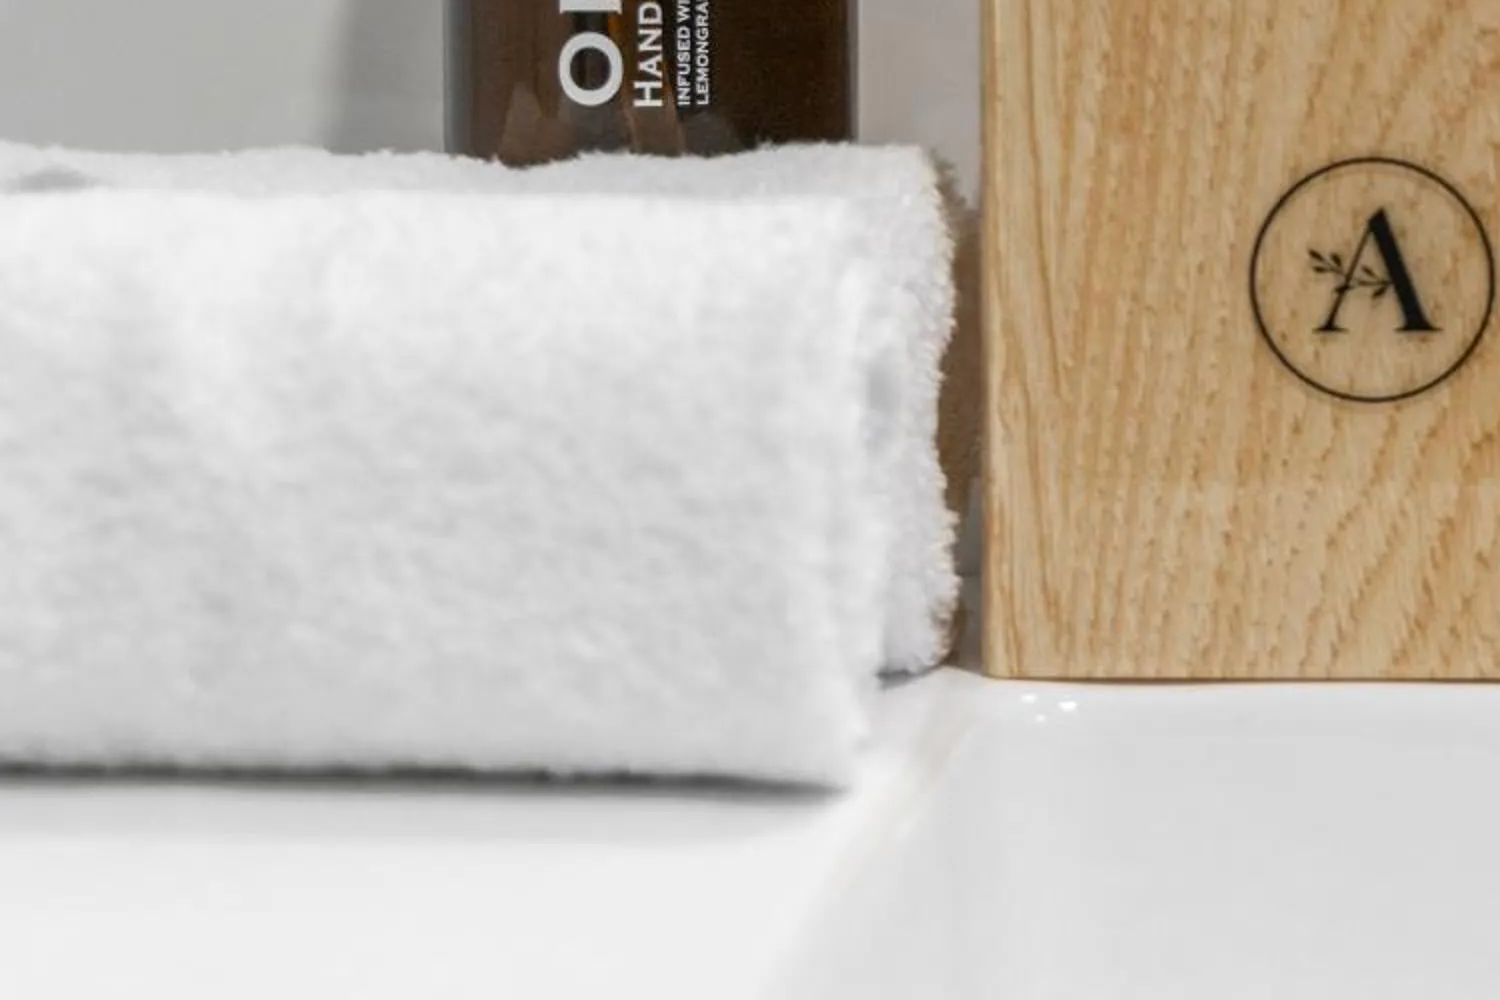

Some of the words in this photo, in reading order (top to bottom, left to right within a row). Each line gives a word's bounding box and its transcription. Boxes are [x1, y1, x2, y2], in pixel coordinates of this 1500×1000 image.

[633, 2, 663, 108] HAND
[677, 26, 690, 105] INFUSED
[1311, 206, 1444, 334] A
